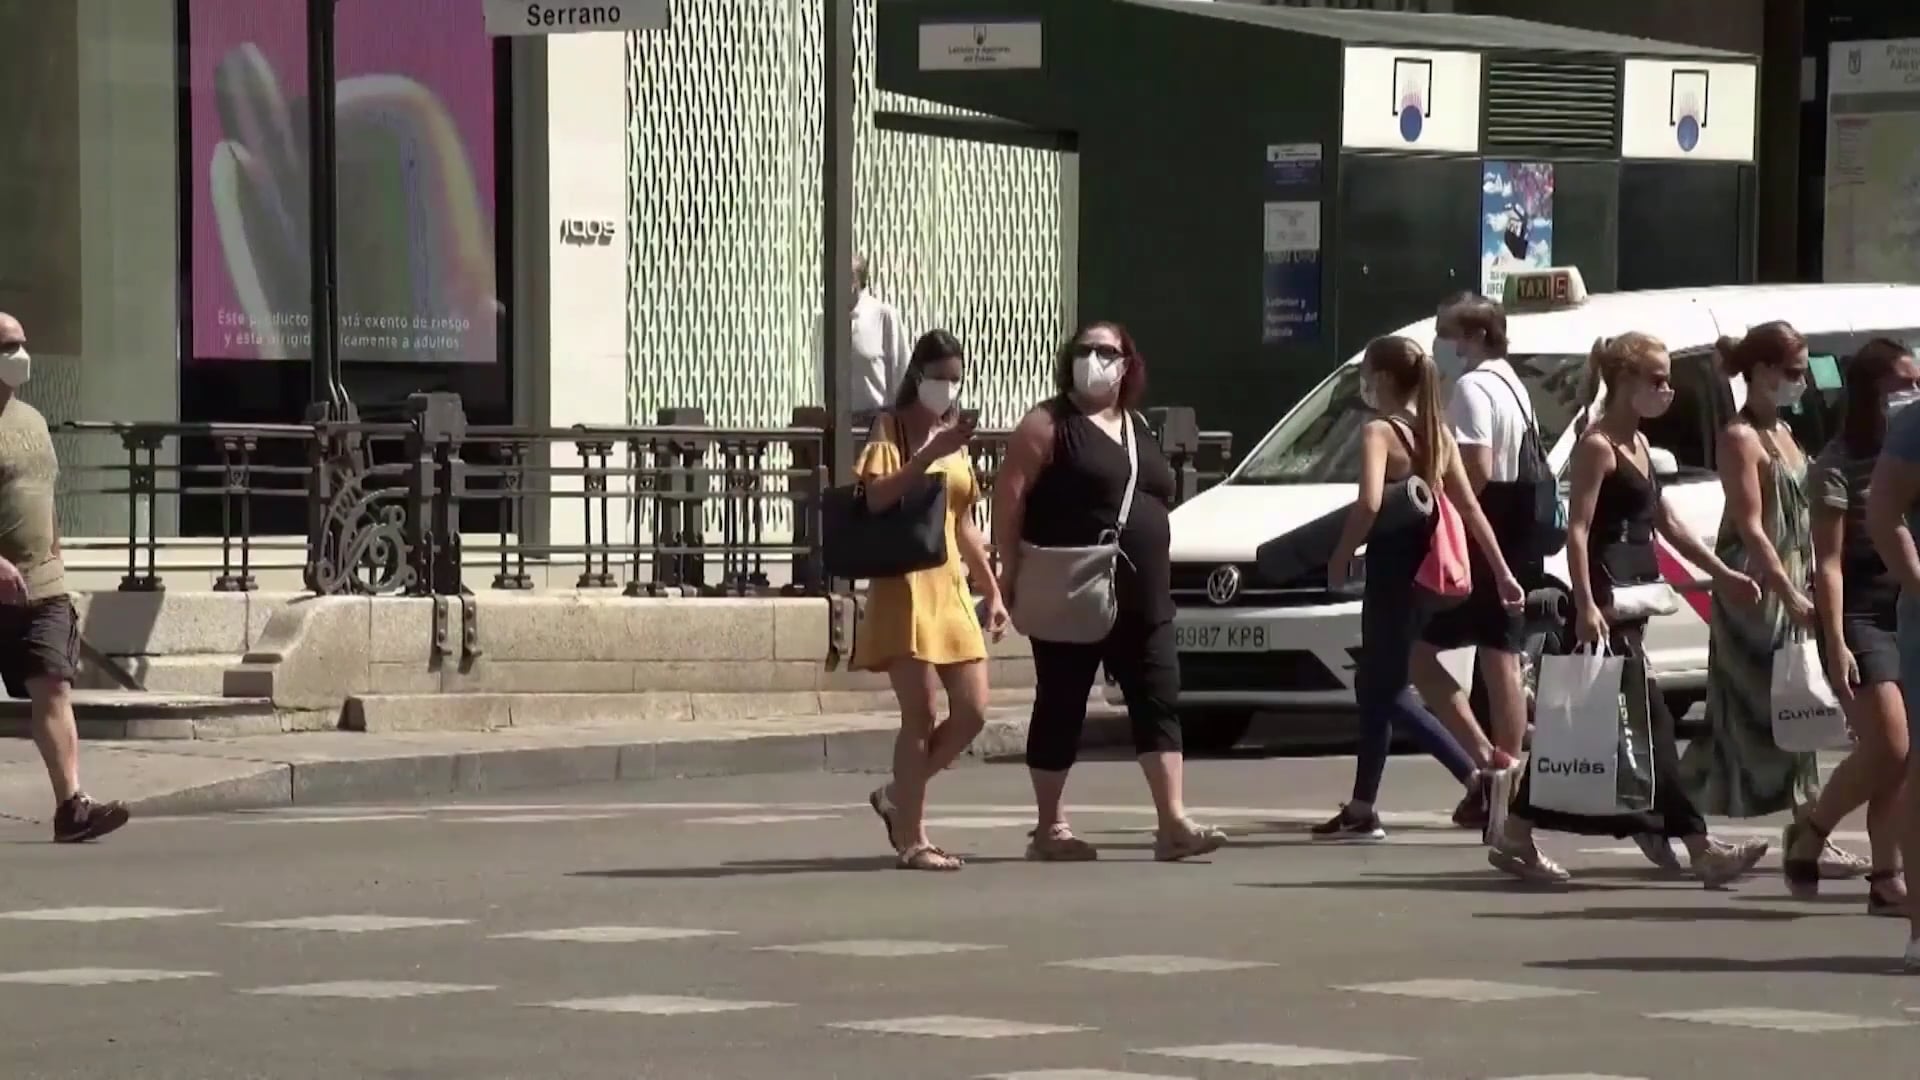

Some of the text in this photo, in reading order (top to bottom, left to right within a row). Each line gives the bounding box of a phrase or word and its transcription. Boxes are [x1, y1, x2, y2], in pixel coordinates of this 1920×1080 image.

[527, 4, 621, 26] Serrano
[1519, 279, 1552, 298] TAXI
[364, 315, 408, 329] exento
[412, 314, 428, 329] de
[431, 315, 470, 332] riesgo
[223, 332, 232, 349] y
[402, 335, 410, 349] a
[1175, 625, 1265, 648] 8987 KPB
[1537, 756, 1606, 777] Cuylás
